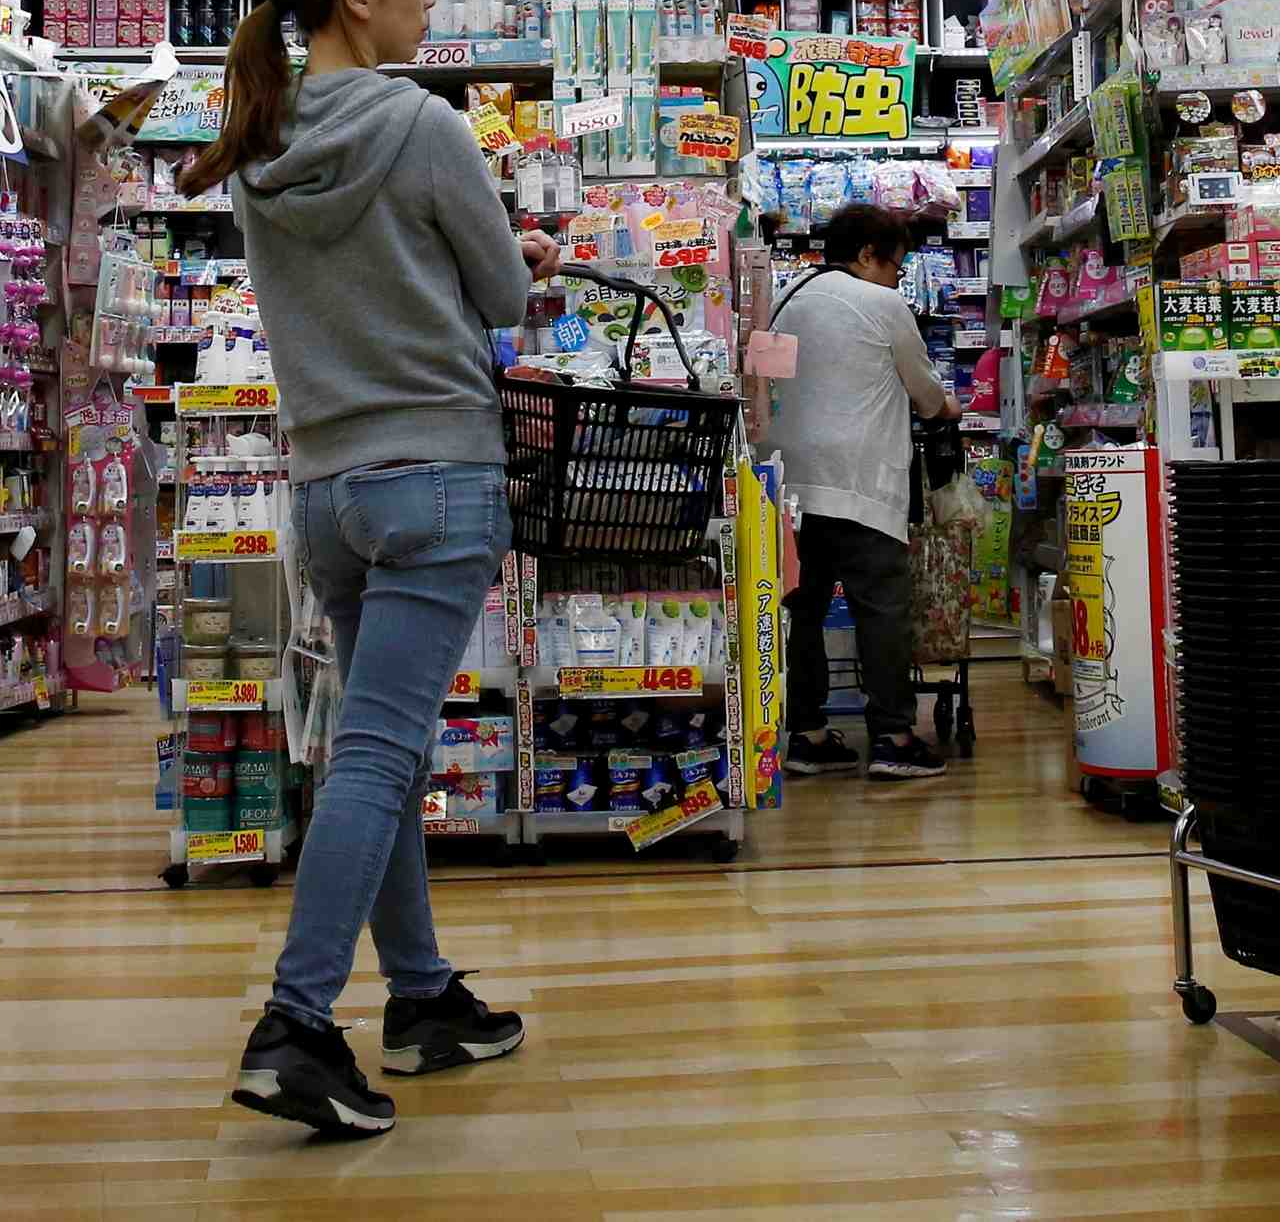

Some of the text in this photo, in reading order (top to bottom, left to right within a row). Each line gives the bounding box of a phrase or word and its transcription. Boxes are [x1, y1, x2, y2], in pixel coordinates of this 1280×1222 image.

[1236, 26, 1275, 42] Jewel
[149, 99, 204, 120] こだわりの
[788, 63, 908, 140] 防虫
[1163, 295, 1223, 314] 大麦若葉
[558, 318, 586, 349] 朝
[234, 388, 269, 408] 298
[233, 535, 268, 555] 298
[756, 581, 775, 725] ヘア速乾スプレー
[641, 668, 693, 691] 498
